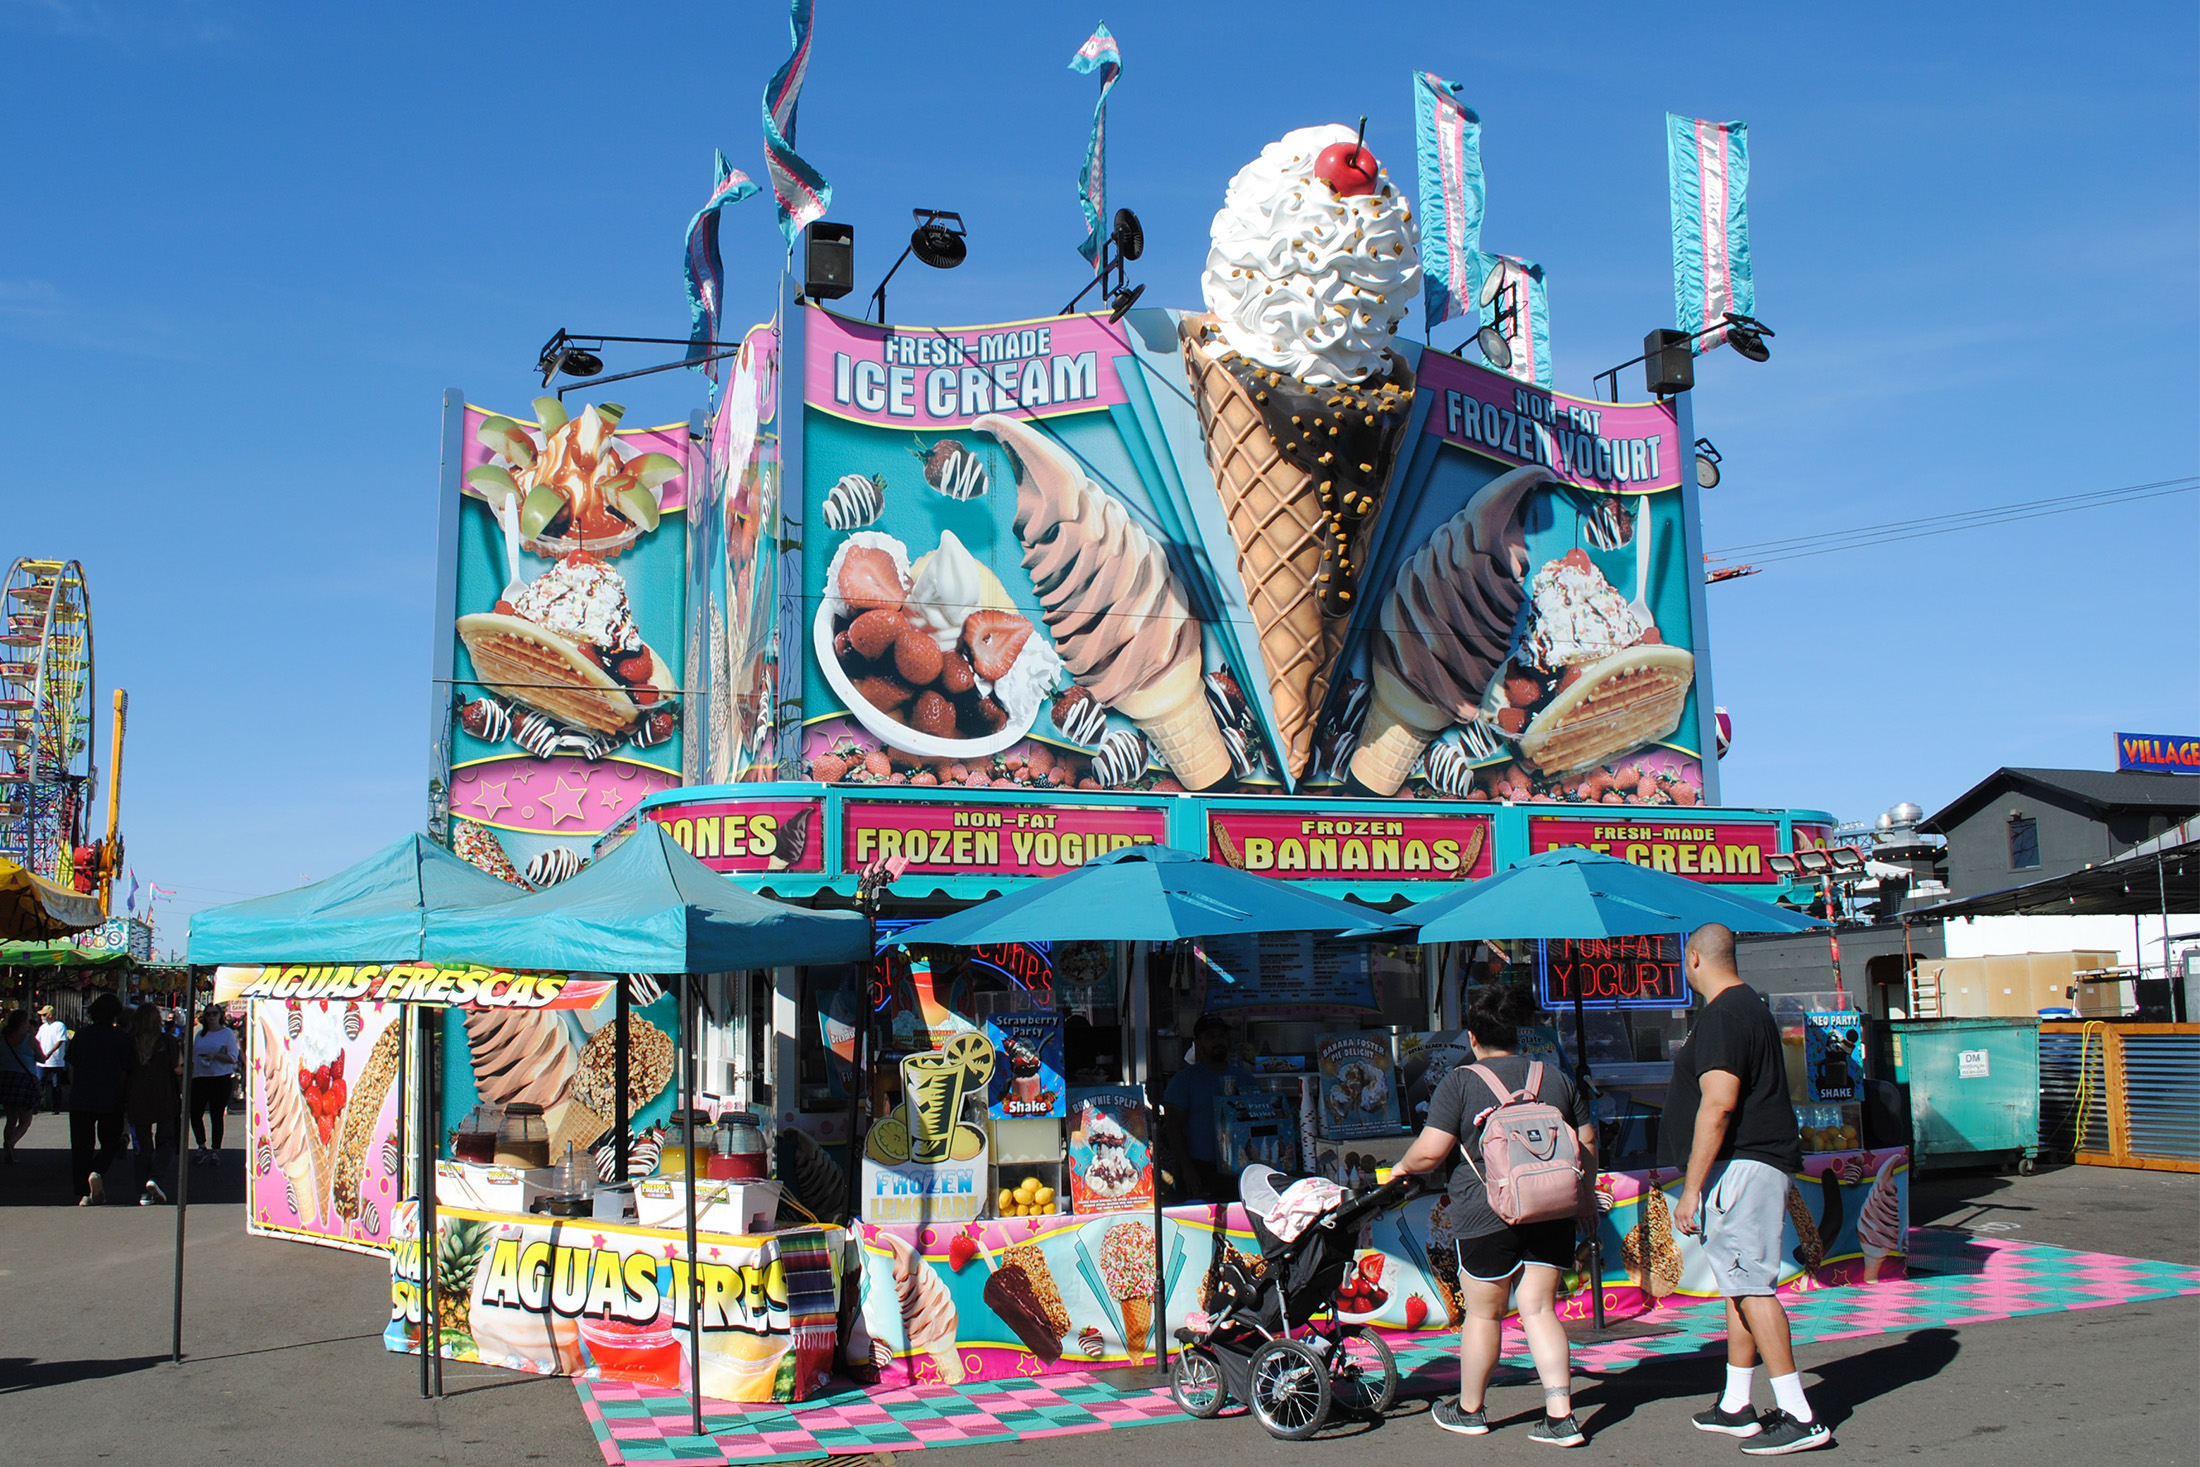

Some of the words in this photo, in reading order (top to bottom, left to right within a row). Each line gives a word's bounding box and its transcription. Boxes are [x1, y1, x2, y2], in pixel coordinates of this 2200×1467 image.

[885, 328, 1050, 365] FRESH-MADE
[833, 351, 915, 417] ICE
[925, 351, 1097, 418] CREAM
[1515, 388, 1601, 436] NON-FAT
[1446, 389, 1554, 468] FROZEN
[1559, 429, 1661, 482] YOGURT
[2123, 739, 2200, 766] VILLAGE
[954, 811, 1058, 829] NON-FAT
[1301, 820, 1403, 836] FROZEN
[1594, 826, 1716, 841] FRESH-MADE
[856, 828, 1000, 865] FROZEN
[1011, 831, 1153, 866] YOGU
[1244, 837, 1461, 872] BANANAS
[1626, 843, 1762, 874] CREAM
[239, 965, 383, 1000] AGUAS
[374, 965, 569, 1007] FRESCAS
[1553, 962, 1680, 997] YOGURT
[996, 1015, 1059, 1026] Strawberry
[1807, 1015, 1830, 1026] OREO
[1830, 1015, 1859, 1026] PARTY
[1013, 1026, 1043, 1037] Party
[1322, 1038, 1355, 1058] BANANA
[1356, 1038, 1386, 1055] FOSTER
[1331, 1051, 1343, 1063] PIE
[1344, 1048, 1375, 1060] DELIGHT
[1449, 1043, 1467, 1051] WHITE
[1965, 1053, 1980, 1063] DM
[1820, 1087, 1852, 1098] SHAKE
[1009, 1100, 1047, 1113] Shake
[1072, 1094, 1112, 1114] BROWNIE
[1113, 1094, 1138, 1110] SPLIT
[641, 1182, 670, 1194] PINEAPPLE
[876, 1168, 974, 1195] FROZEN
[870, 1196, 978, 1219] LEMONADE
[482, 1238, 660, 1326] AGUAS
